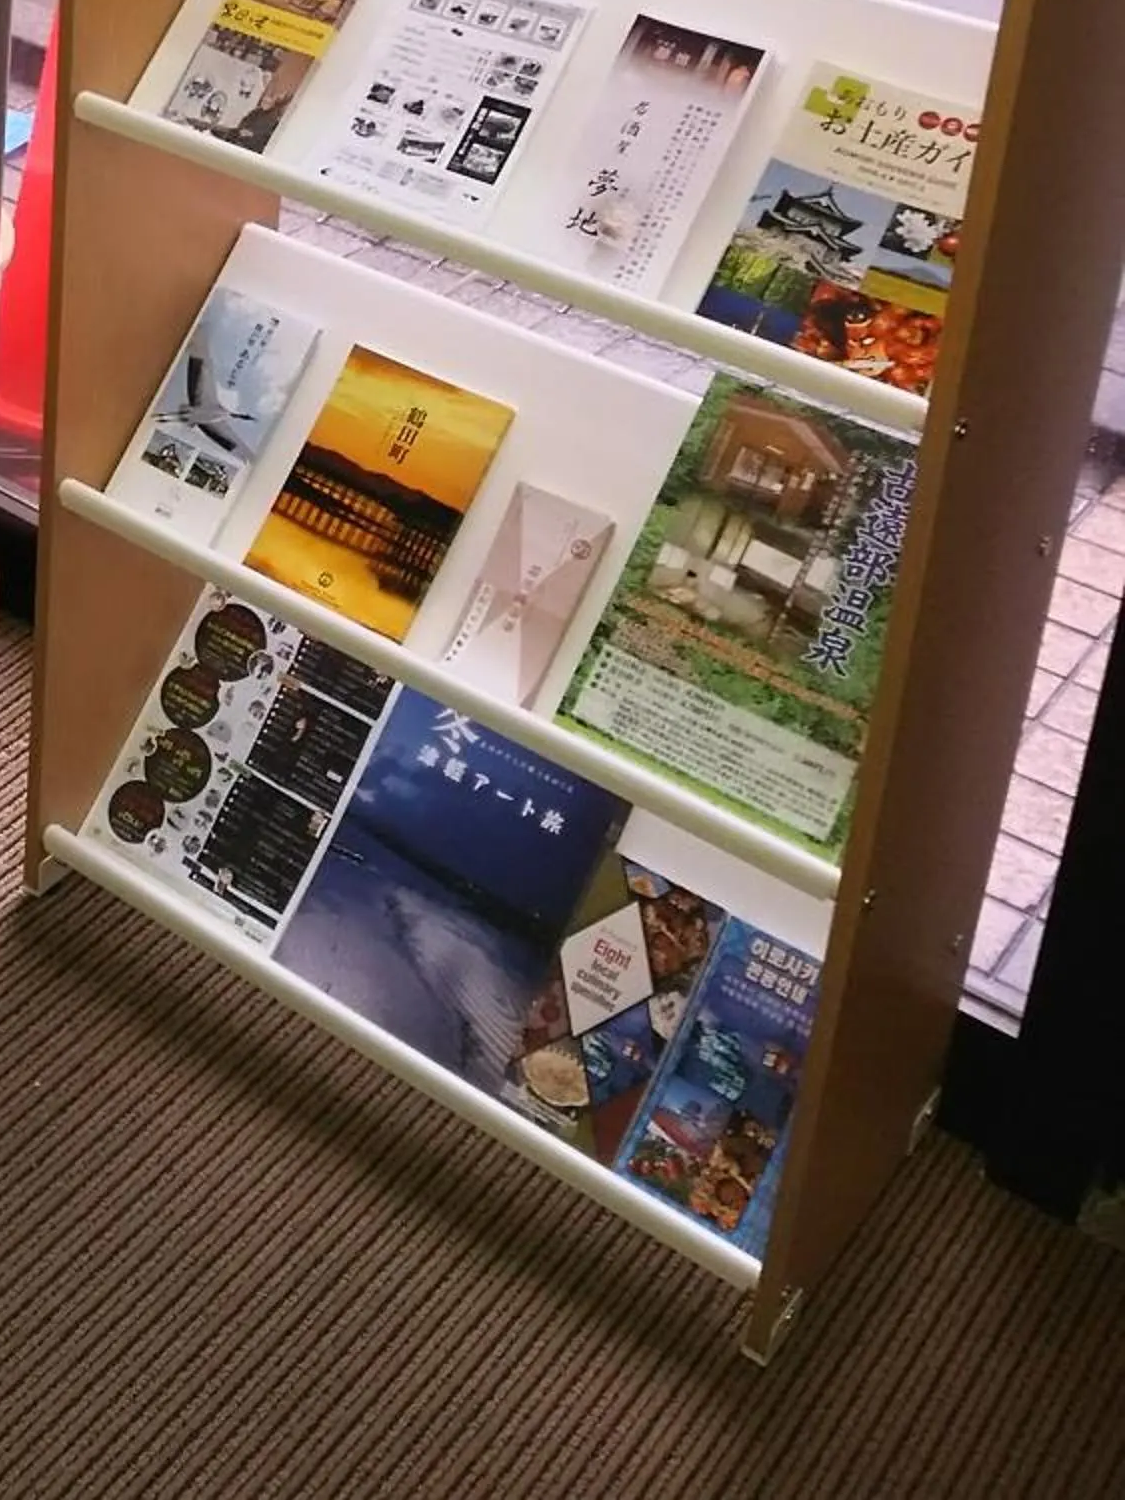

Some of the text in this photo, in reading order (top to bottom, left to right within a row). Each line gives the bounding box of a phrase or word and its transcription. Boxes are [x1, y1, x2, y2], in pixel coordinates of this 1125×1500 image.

[565, 168, 620, 237] 夢地
[388, 405, 427, 465] 鶴田町
[803, 460, 917, 679] 古遠部温泉
[594, 938, 632, 971] Eight
